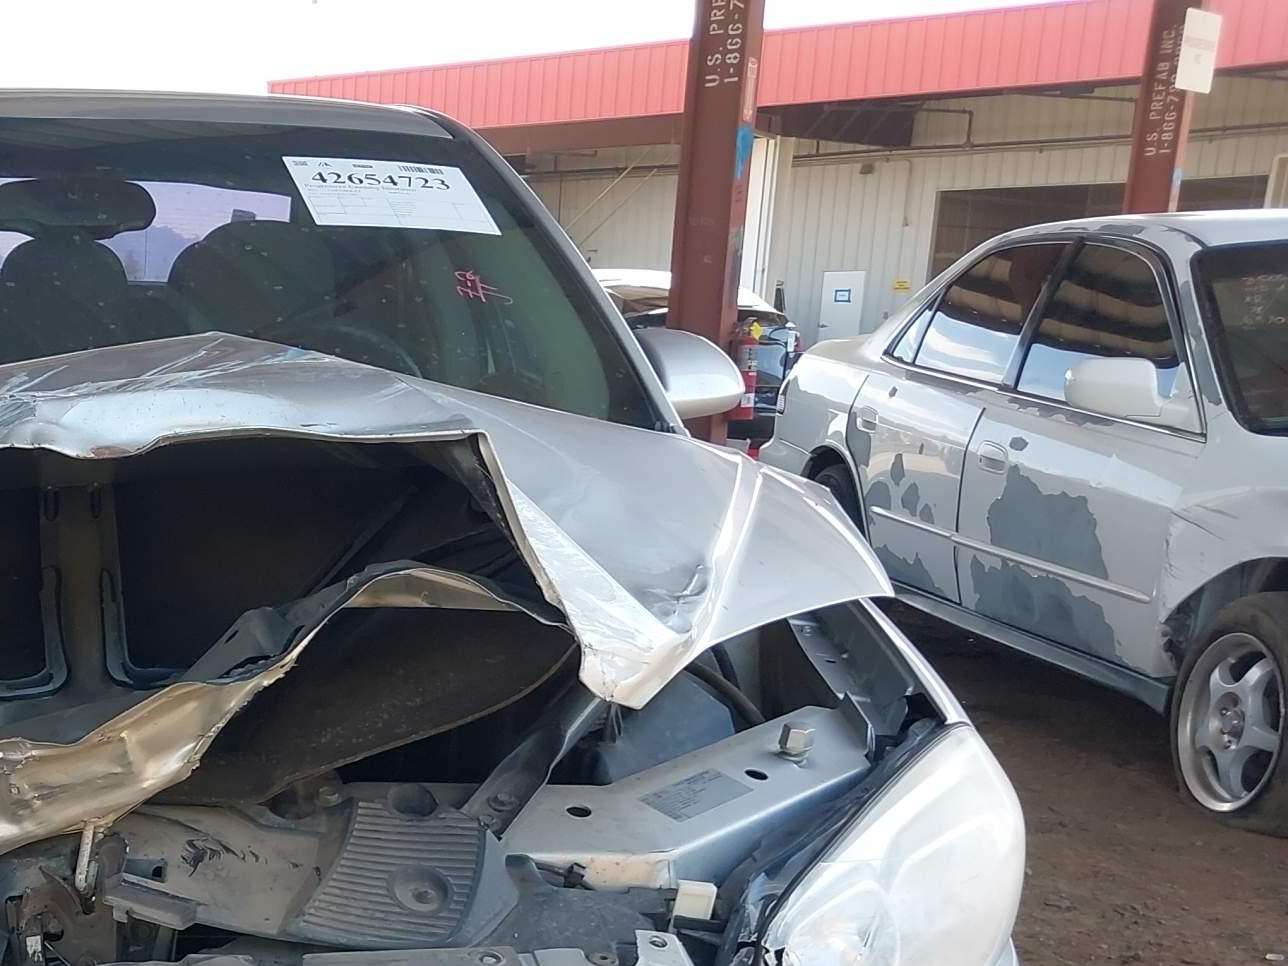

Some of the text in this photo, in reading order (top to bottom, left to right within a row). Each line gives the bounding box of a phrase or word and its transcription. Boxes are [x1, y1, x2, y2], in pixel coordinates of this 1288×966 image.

[705, 47, 723, 88] U.S.
[1149, 62, 1171, 120] PREFAB
[1144, 128, 1161, 157] U.S.
[311, 171, 451, 191] 42654723
